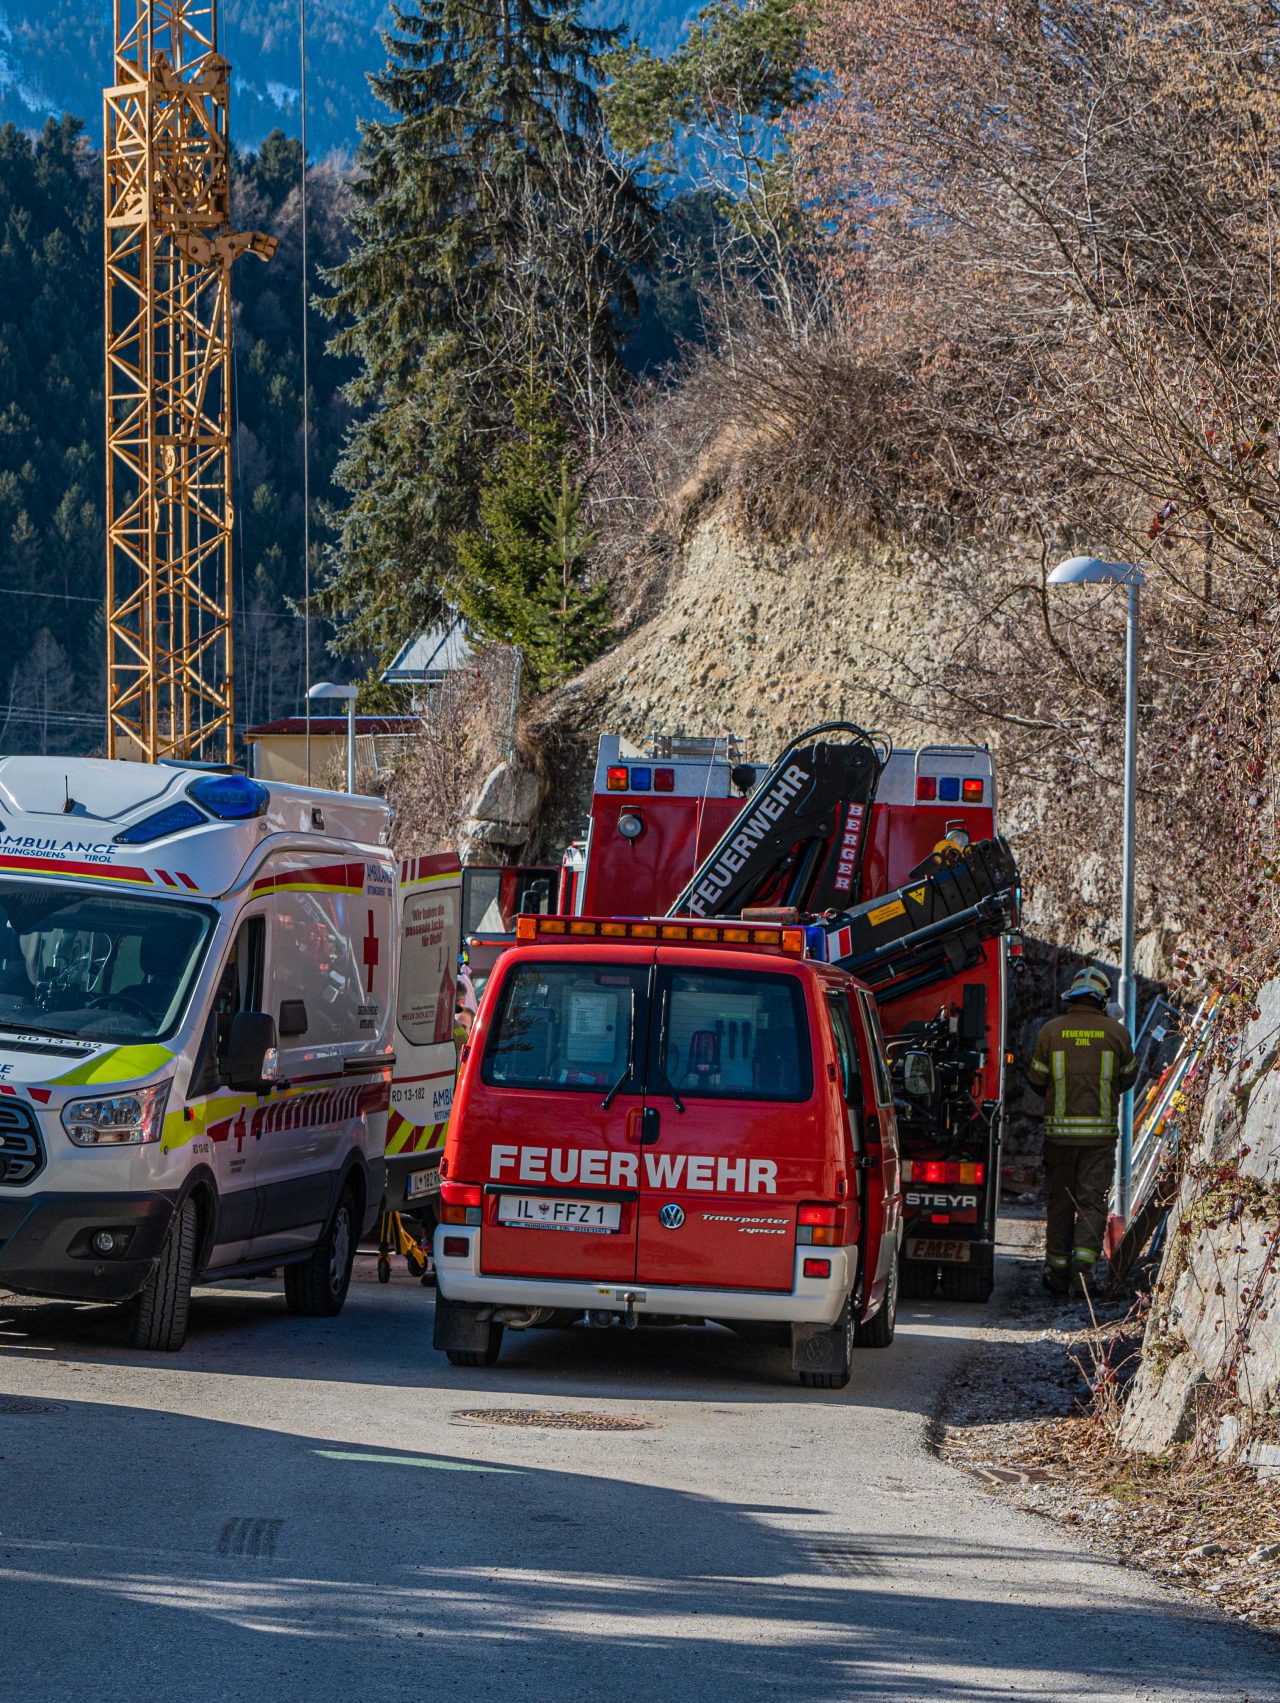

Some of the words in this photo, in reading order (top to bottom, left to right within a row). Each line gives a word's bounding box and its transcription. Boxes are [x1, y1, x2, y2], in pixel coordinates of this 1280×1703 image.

[686, 764, 810, 917] FEUERWEHR
[836, 803, 863, 890] BERGER
[84, 853, 112, 863] TIROL
[17, 1034, 39, 1043] RD
[45, 1038, 103, 1050] 13-182
[1061, 1030, 1105, 1039] FEUERWEHR
[392, 1089, 402, 1102] RD
[404, 1087, 425, 1101] 13-182
[490, 1144, 778, 1194] FEUERWEHR
[906, 1192, 977, 1208] STEYR
[518, 1200, 533, 1218] IL
[553, 1202, 591, 1223] FFZ
[596, 1206, 604, 1224] 1
[702, 1213, 790, 1225] Transporter
[738, 1227, 786, 1235] syncro
[912, 1239, 965, 1260] EMPL
